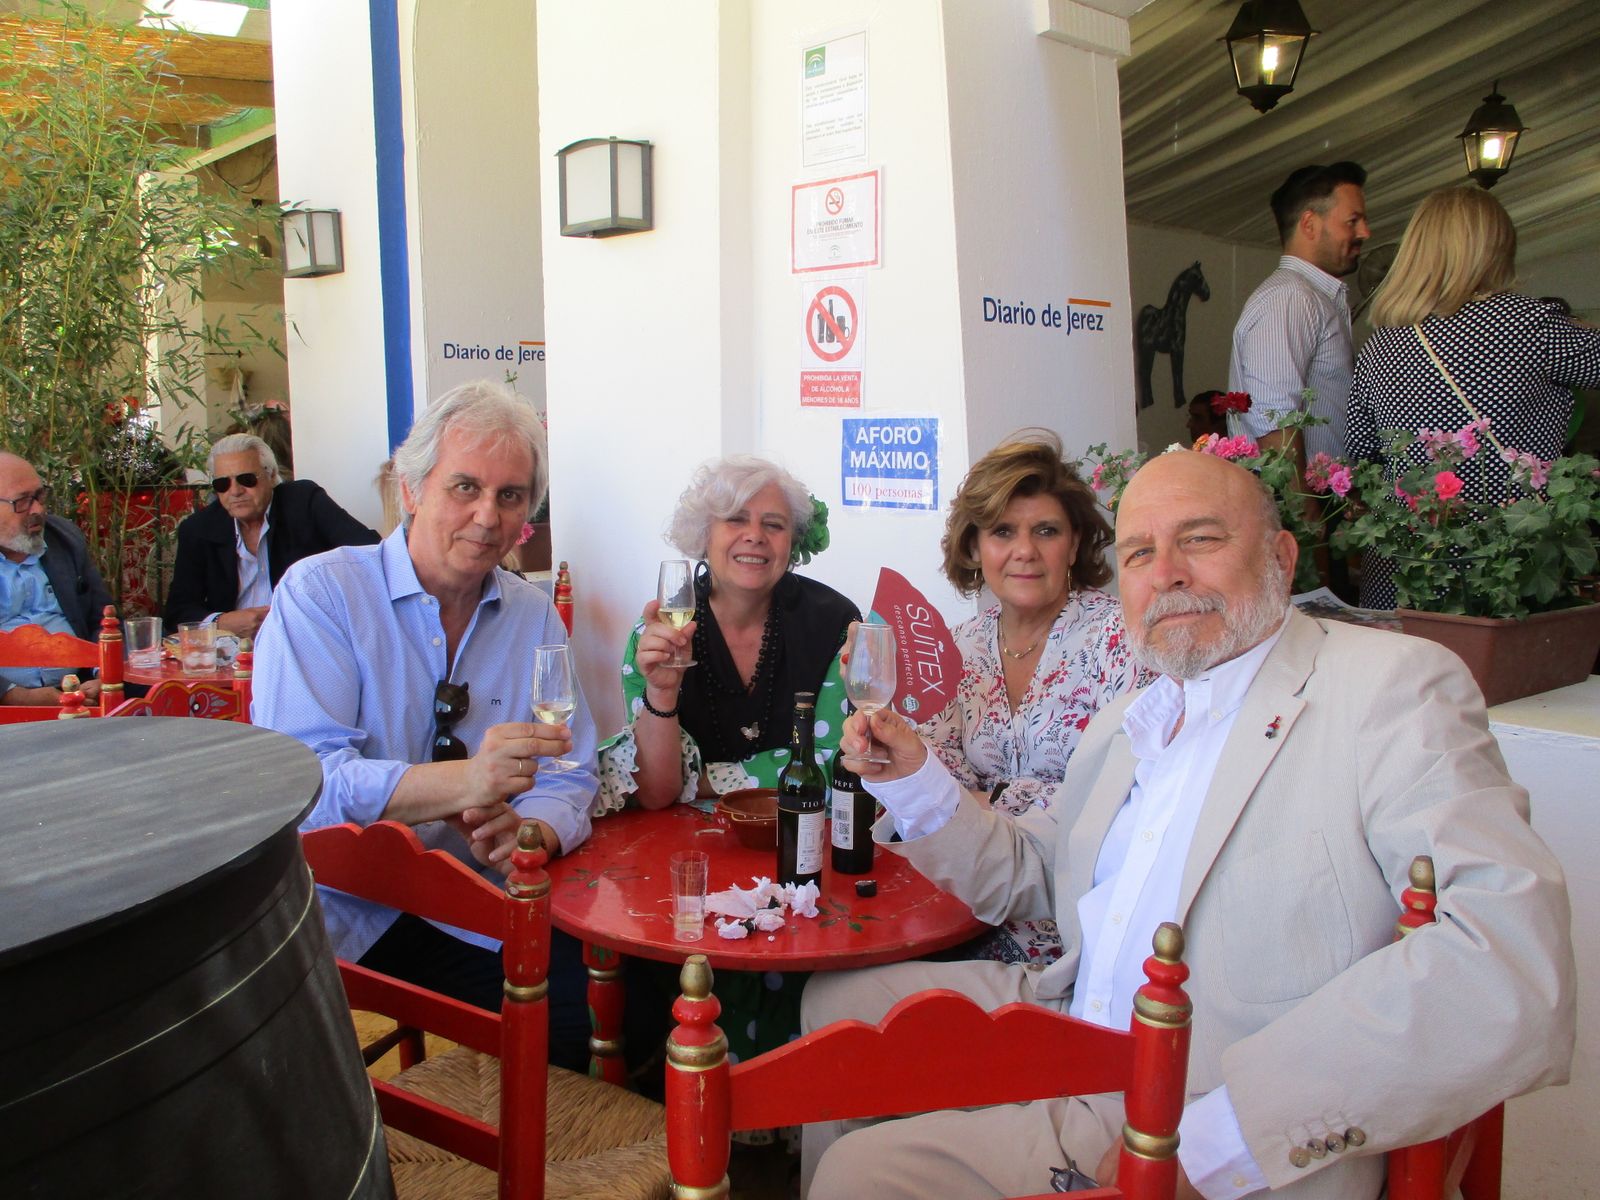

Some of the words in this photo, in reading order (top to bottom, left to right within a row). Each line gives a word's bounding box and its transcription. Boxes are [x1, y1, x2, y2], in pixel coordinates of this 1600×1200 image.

[983, 297, 1036, 326] Diario
[1041, 303, 1062, 328] de
[1066, 305, 1104, 336] Jerez
[443, 343, 490, 360] Diario
[495, 345, 514, 361] de
[518, 345, 545, 365] Jere
[819, 385, 844, 393] ALCOHOL
[856, 426, 922, 445] AFORO
[850, 446, 929, 470] MÁXIMO
[852, 483, 872, 497] 100
[876, 487, 923, 500] personas
[893, 604, 907, 646] descanso
[902, 648, 914, 686] perfecto
